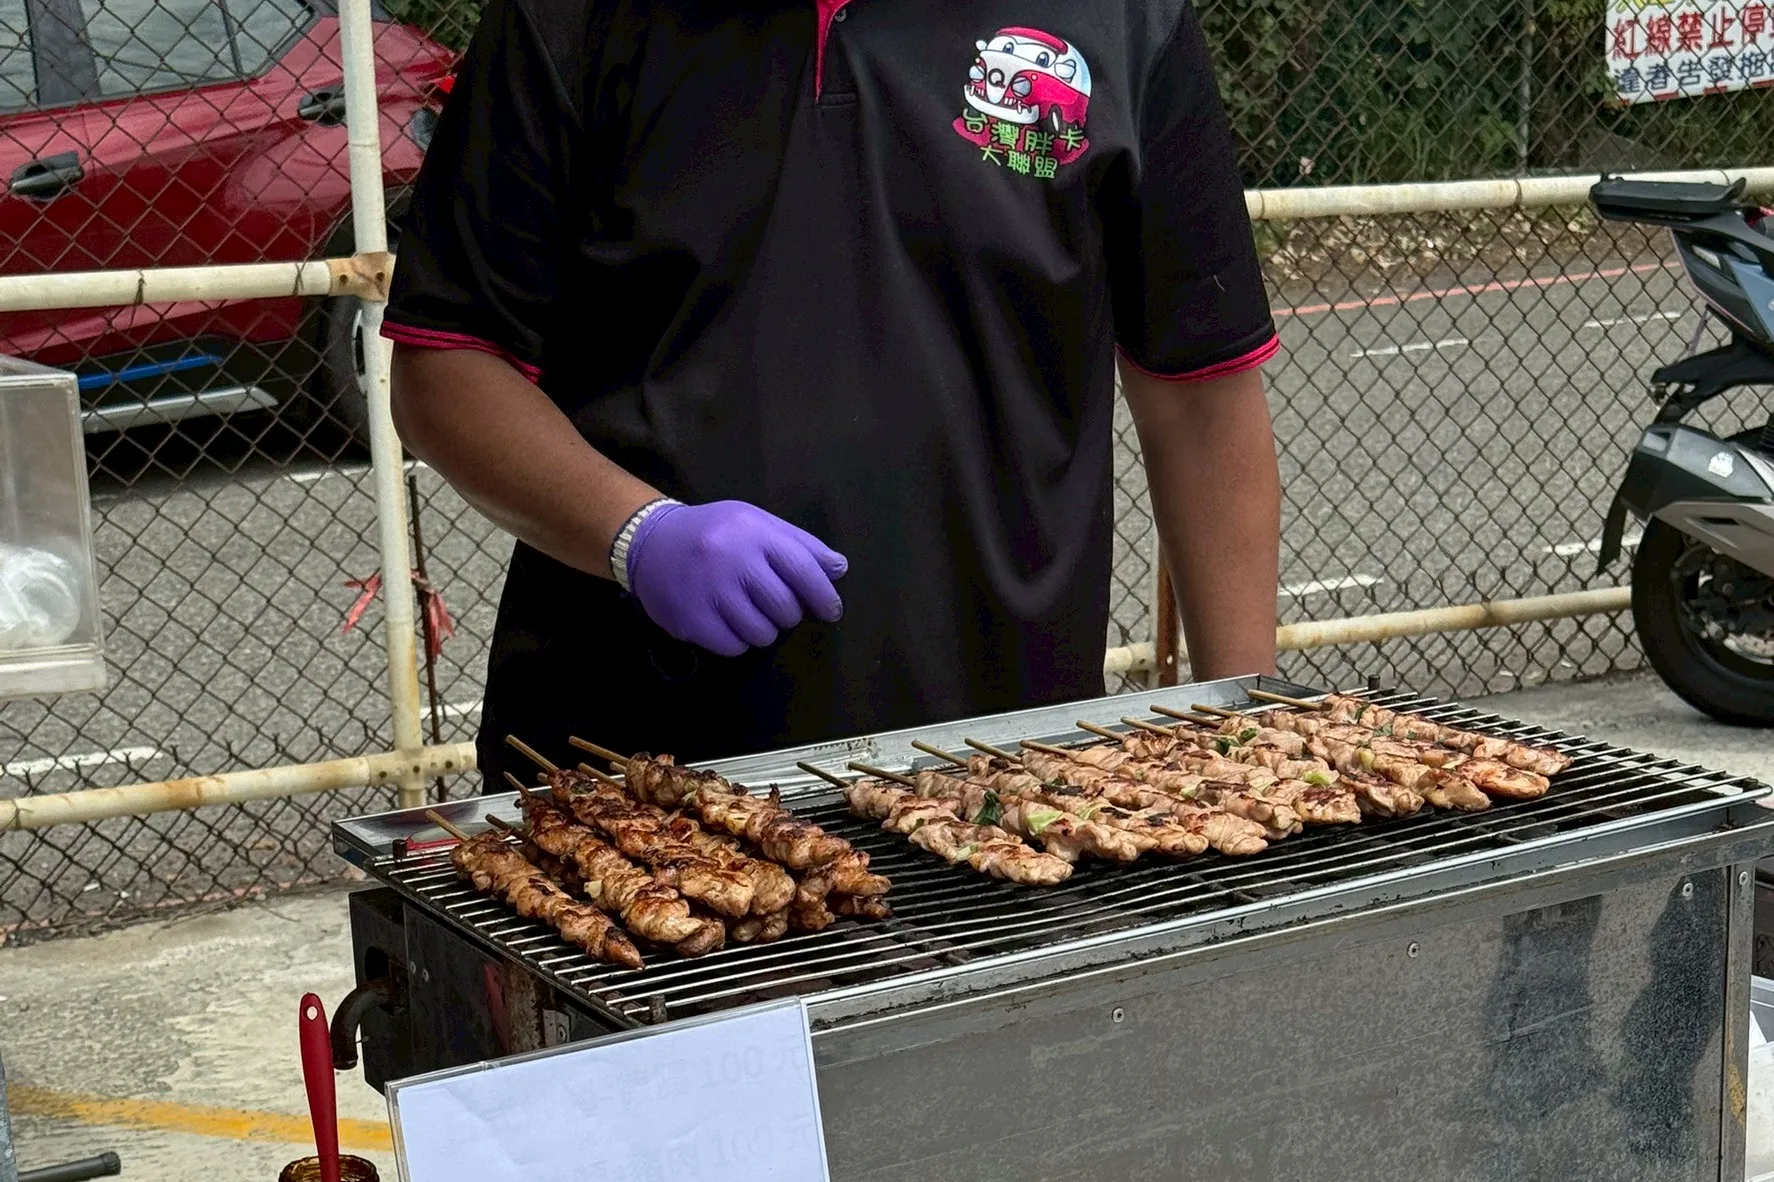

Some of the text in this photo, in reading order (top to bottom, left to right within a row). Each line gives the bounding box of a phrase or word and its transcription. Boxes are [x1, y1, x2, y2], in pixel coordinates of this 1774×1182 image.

[1612, 3, 1774, 60] 紅線禁止停
[963, 108, 1084, 155] 台灣胖卡
[980, 144, 1058, 179] 大聯盟
